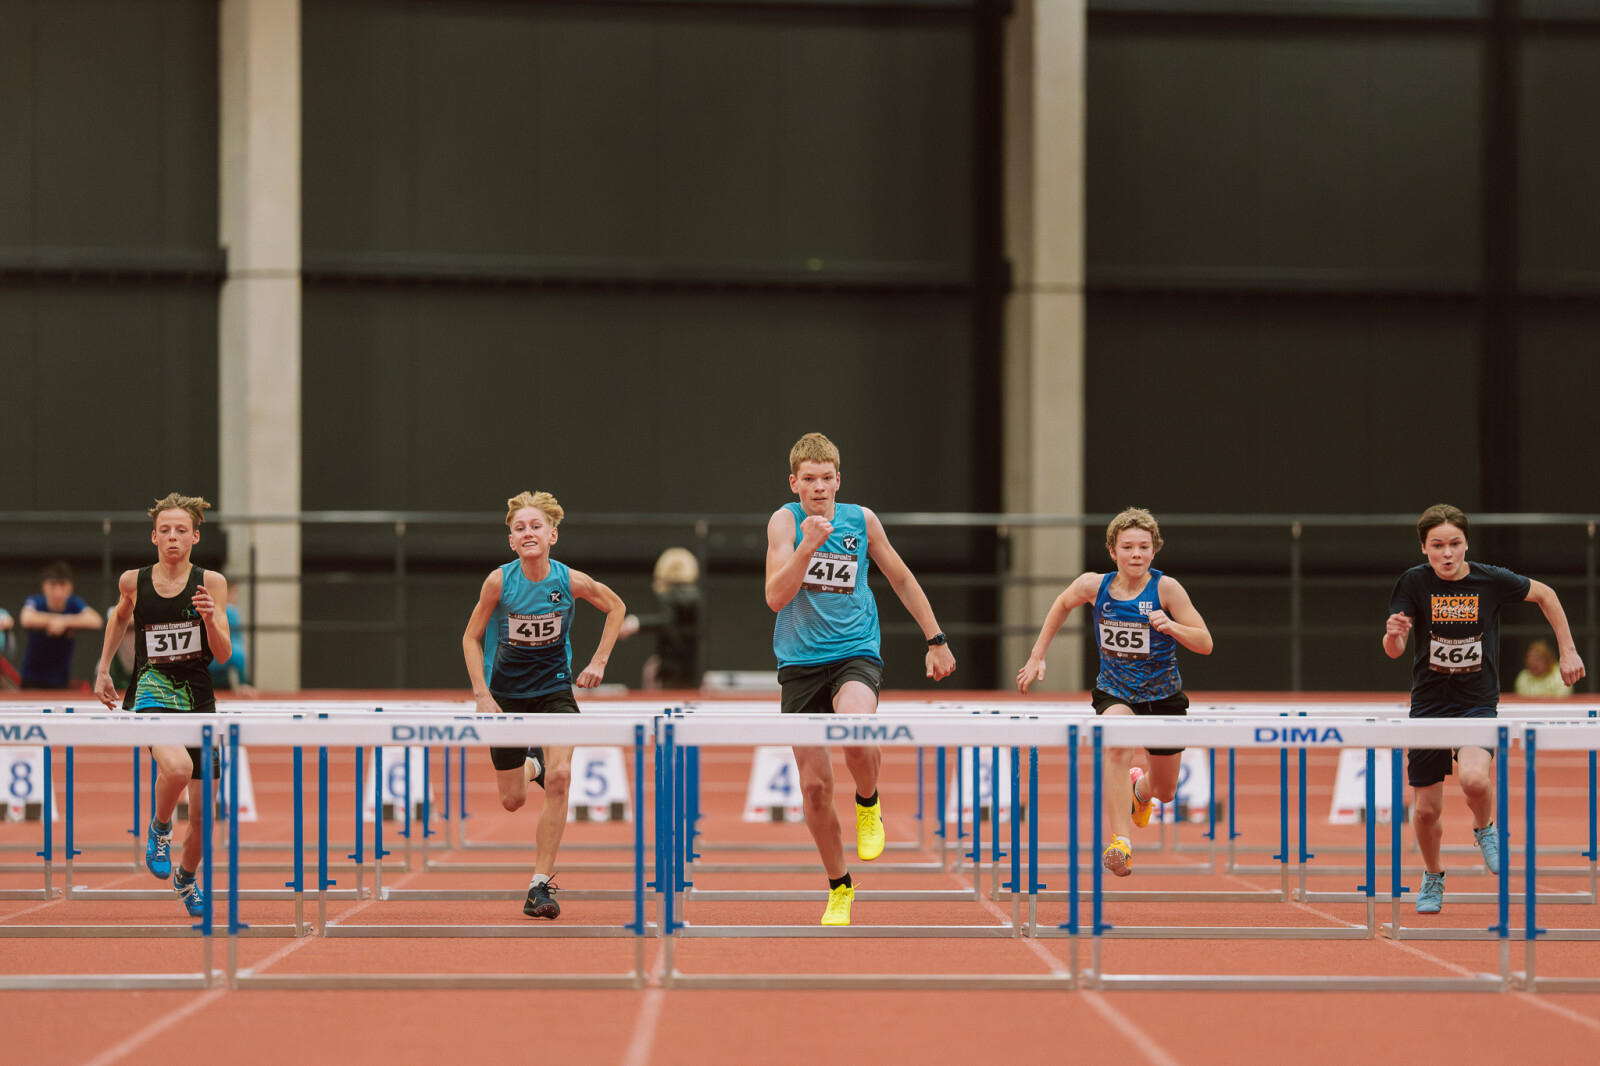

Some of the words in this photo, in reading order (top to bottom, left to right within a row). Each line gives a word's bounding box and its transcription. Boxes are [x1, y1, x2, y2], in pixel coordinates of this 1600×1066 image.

[808, 561, 851, 582] 414
[1434, 609, 1476, 619] JONES
[516, 621, 555, 637] 415
[1103, 628, 1144, 649] 265
[153, 631, 193, 652] 317
[1433, 645, 1480, 664] 464
[391, 725, 481, 741] DIMA
[826, 725, 914, 741] DIMA
[1254, 727, 1344, 743] DIMA
[9, 760, 33, 799] 8
[387, 761, 408, 799] 6
[583, 760, 608, 799] 5
[768, 763, 792, 797] 4
